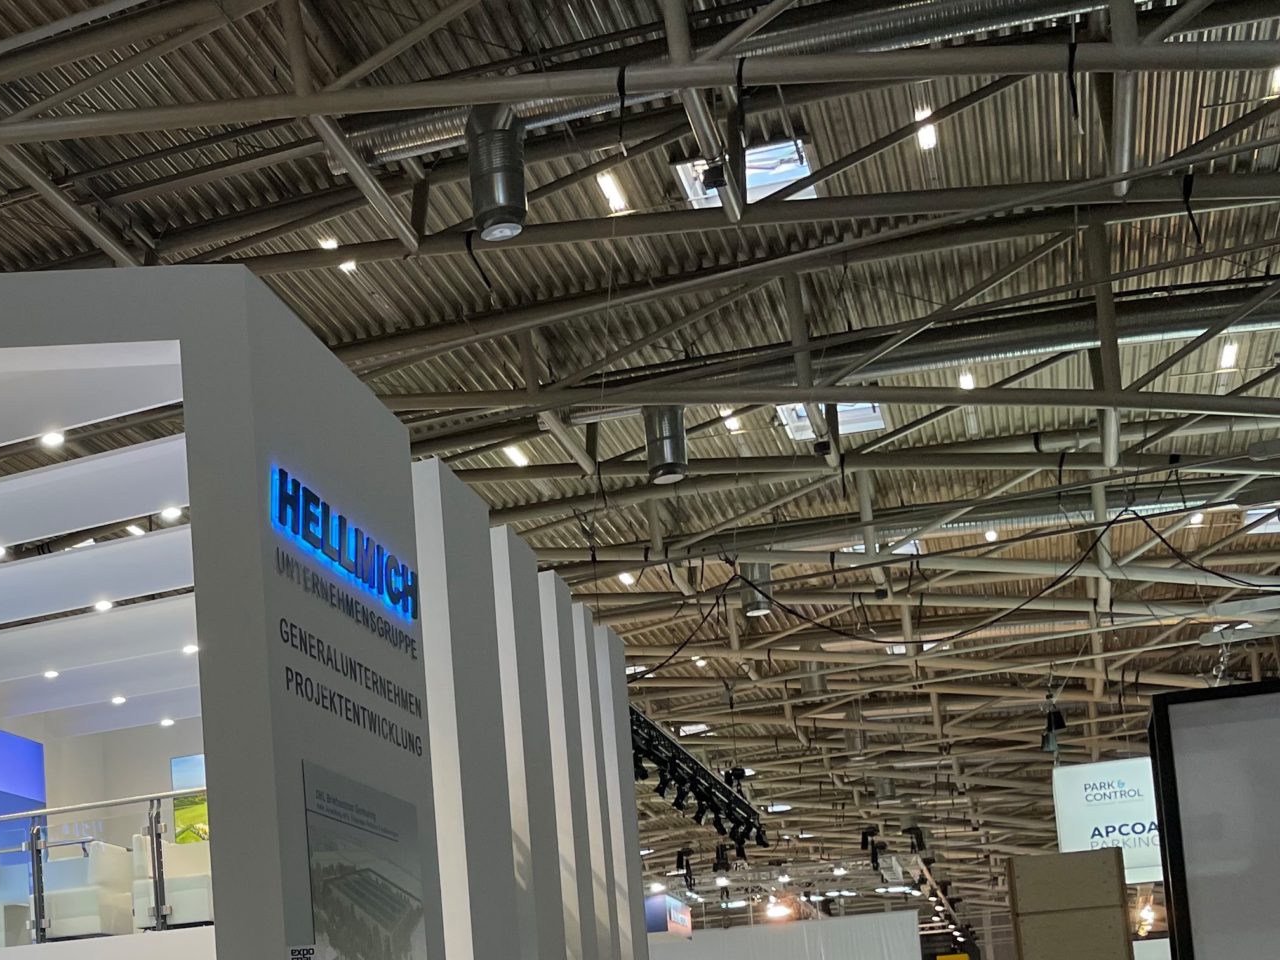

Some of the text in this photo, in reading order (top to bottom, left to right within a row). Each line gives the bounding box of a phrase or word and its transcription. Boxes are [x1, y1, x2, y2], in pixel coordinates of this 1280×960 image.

[274, 466, 418, 621] HELLMICH
[276, 546, 418, 661] UNTERNEHMENSGRUPPE
[279, 617, 422, 720] GENERALUNTERNEHMEN
[285, 666, 423, 758] PROJEKTENTWICKLUNG
[1084, 780, 1115, 792] PARK
[1085, 788, 1144, 803] CONTROL
[1090, 820, 1159, 839] APCOA
[291, 948, 315, 958] expo
